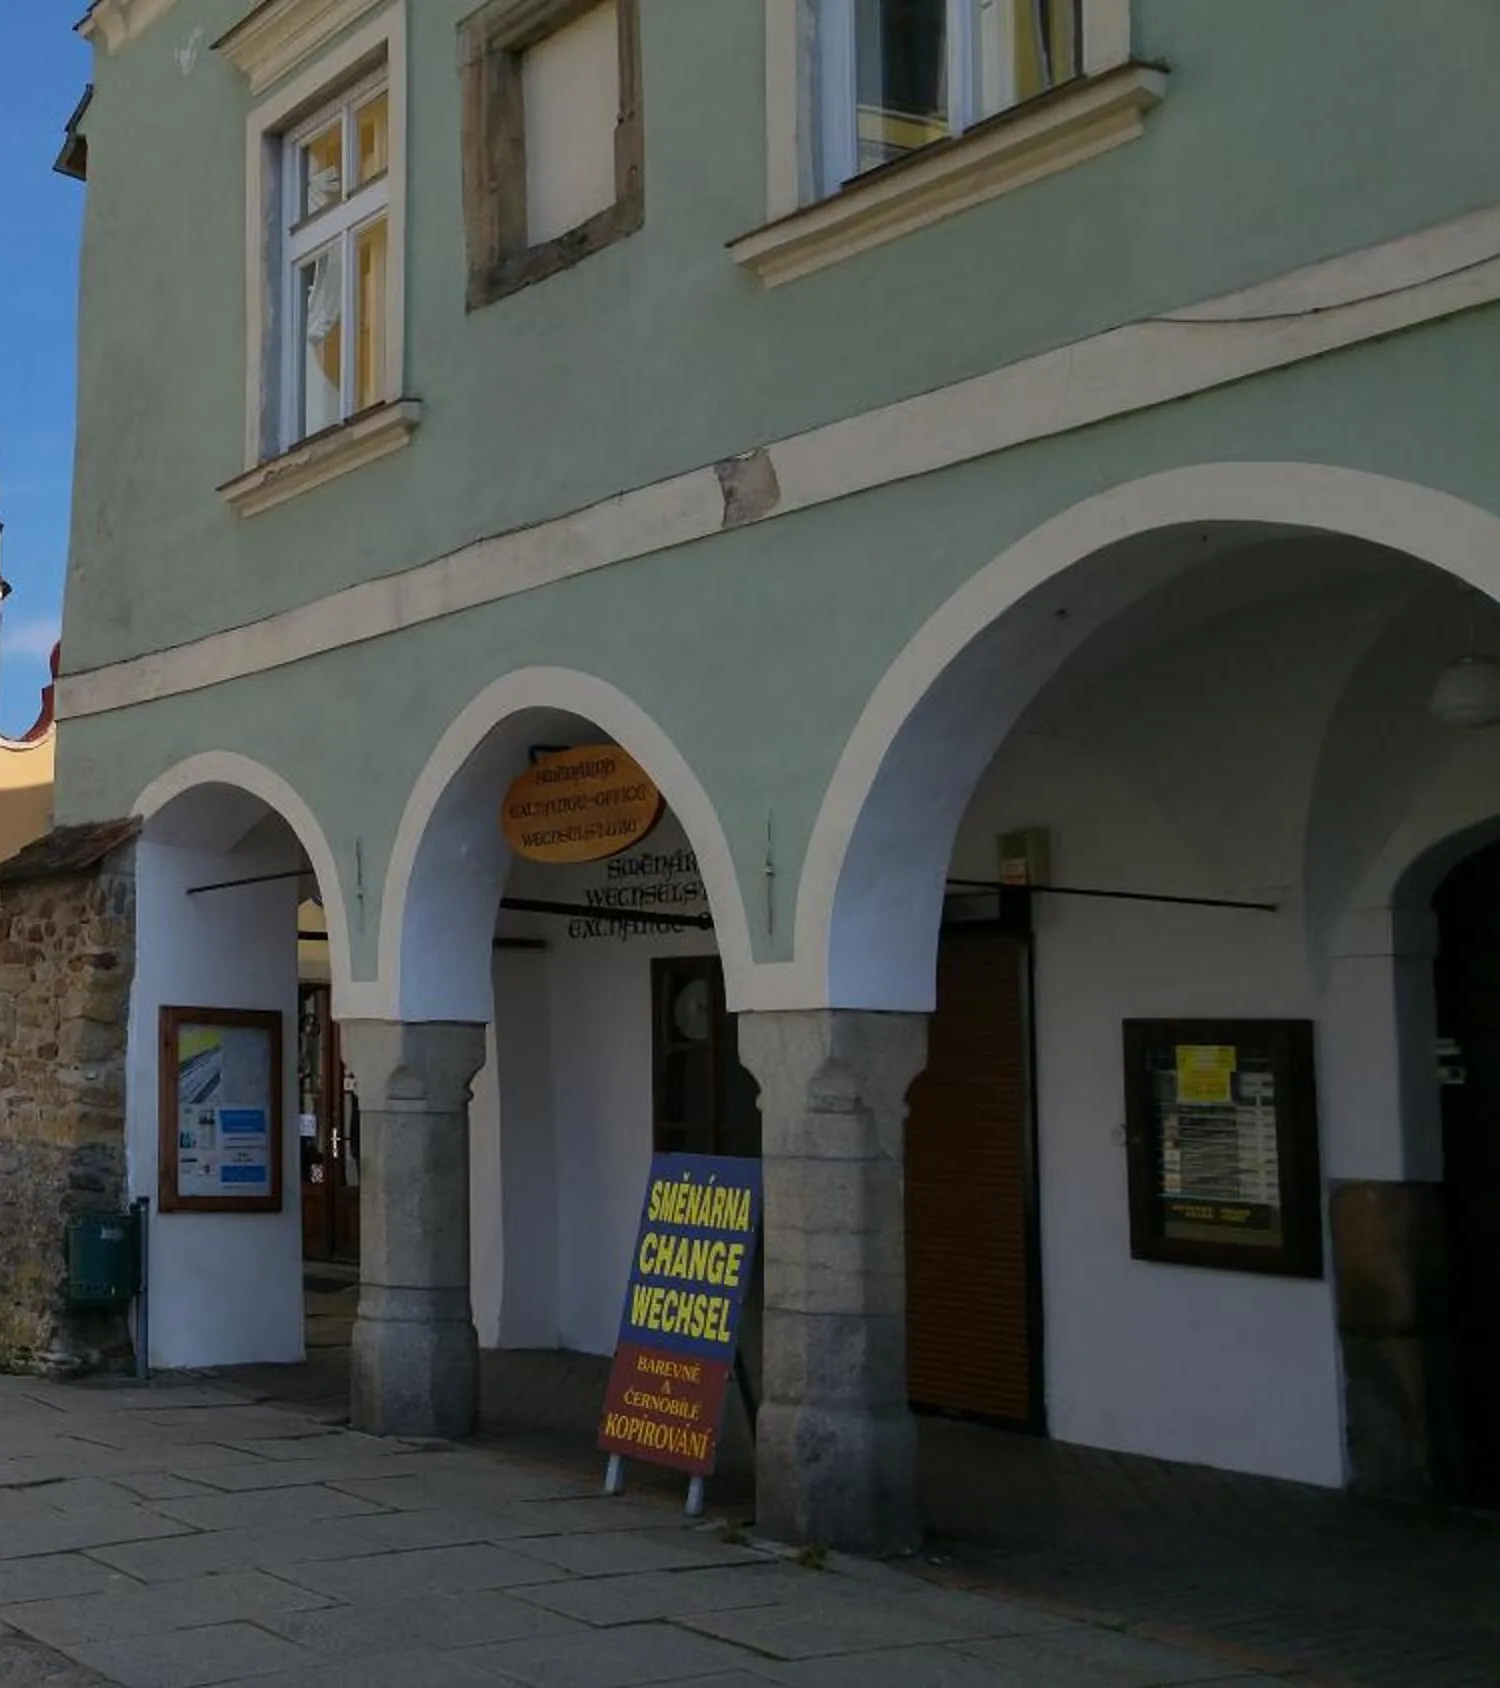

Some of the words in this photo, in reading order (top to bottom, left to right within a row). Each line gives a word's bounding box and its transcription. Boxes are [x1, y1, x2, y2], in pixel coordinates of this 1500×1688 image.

[607, 849, 700, 880] SMĚNÁR
[586, 881, 708, 907] WECHSELS
[648, 1171, 751, 1233] SMĚNÁRNA
[638, 1232, 746, 1288] CHANGE
[631, 1284, 733, 1343] WECHSEL
[636, 1353, 701, 1384] BAREVNÉ
[661, 1380, 672, 1395] A
[605, 1410, 713, 1460] KOPÍROVÁNÍ
